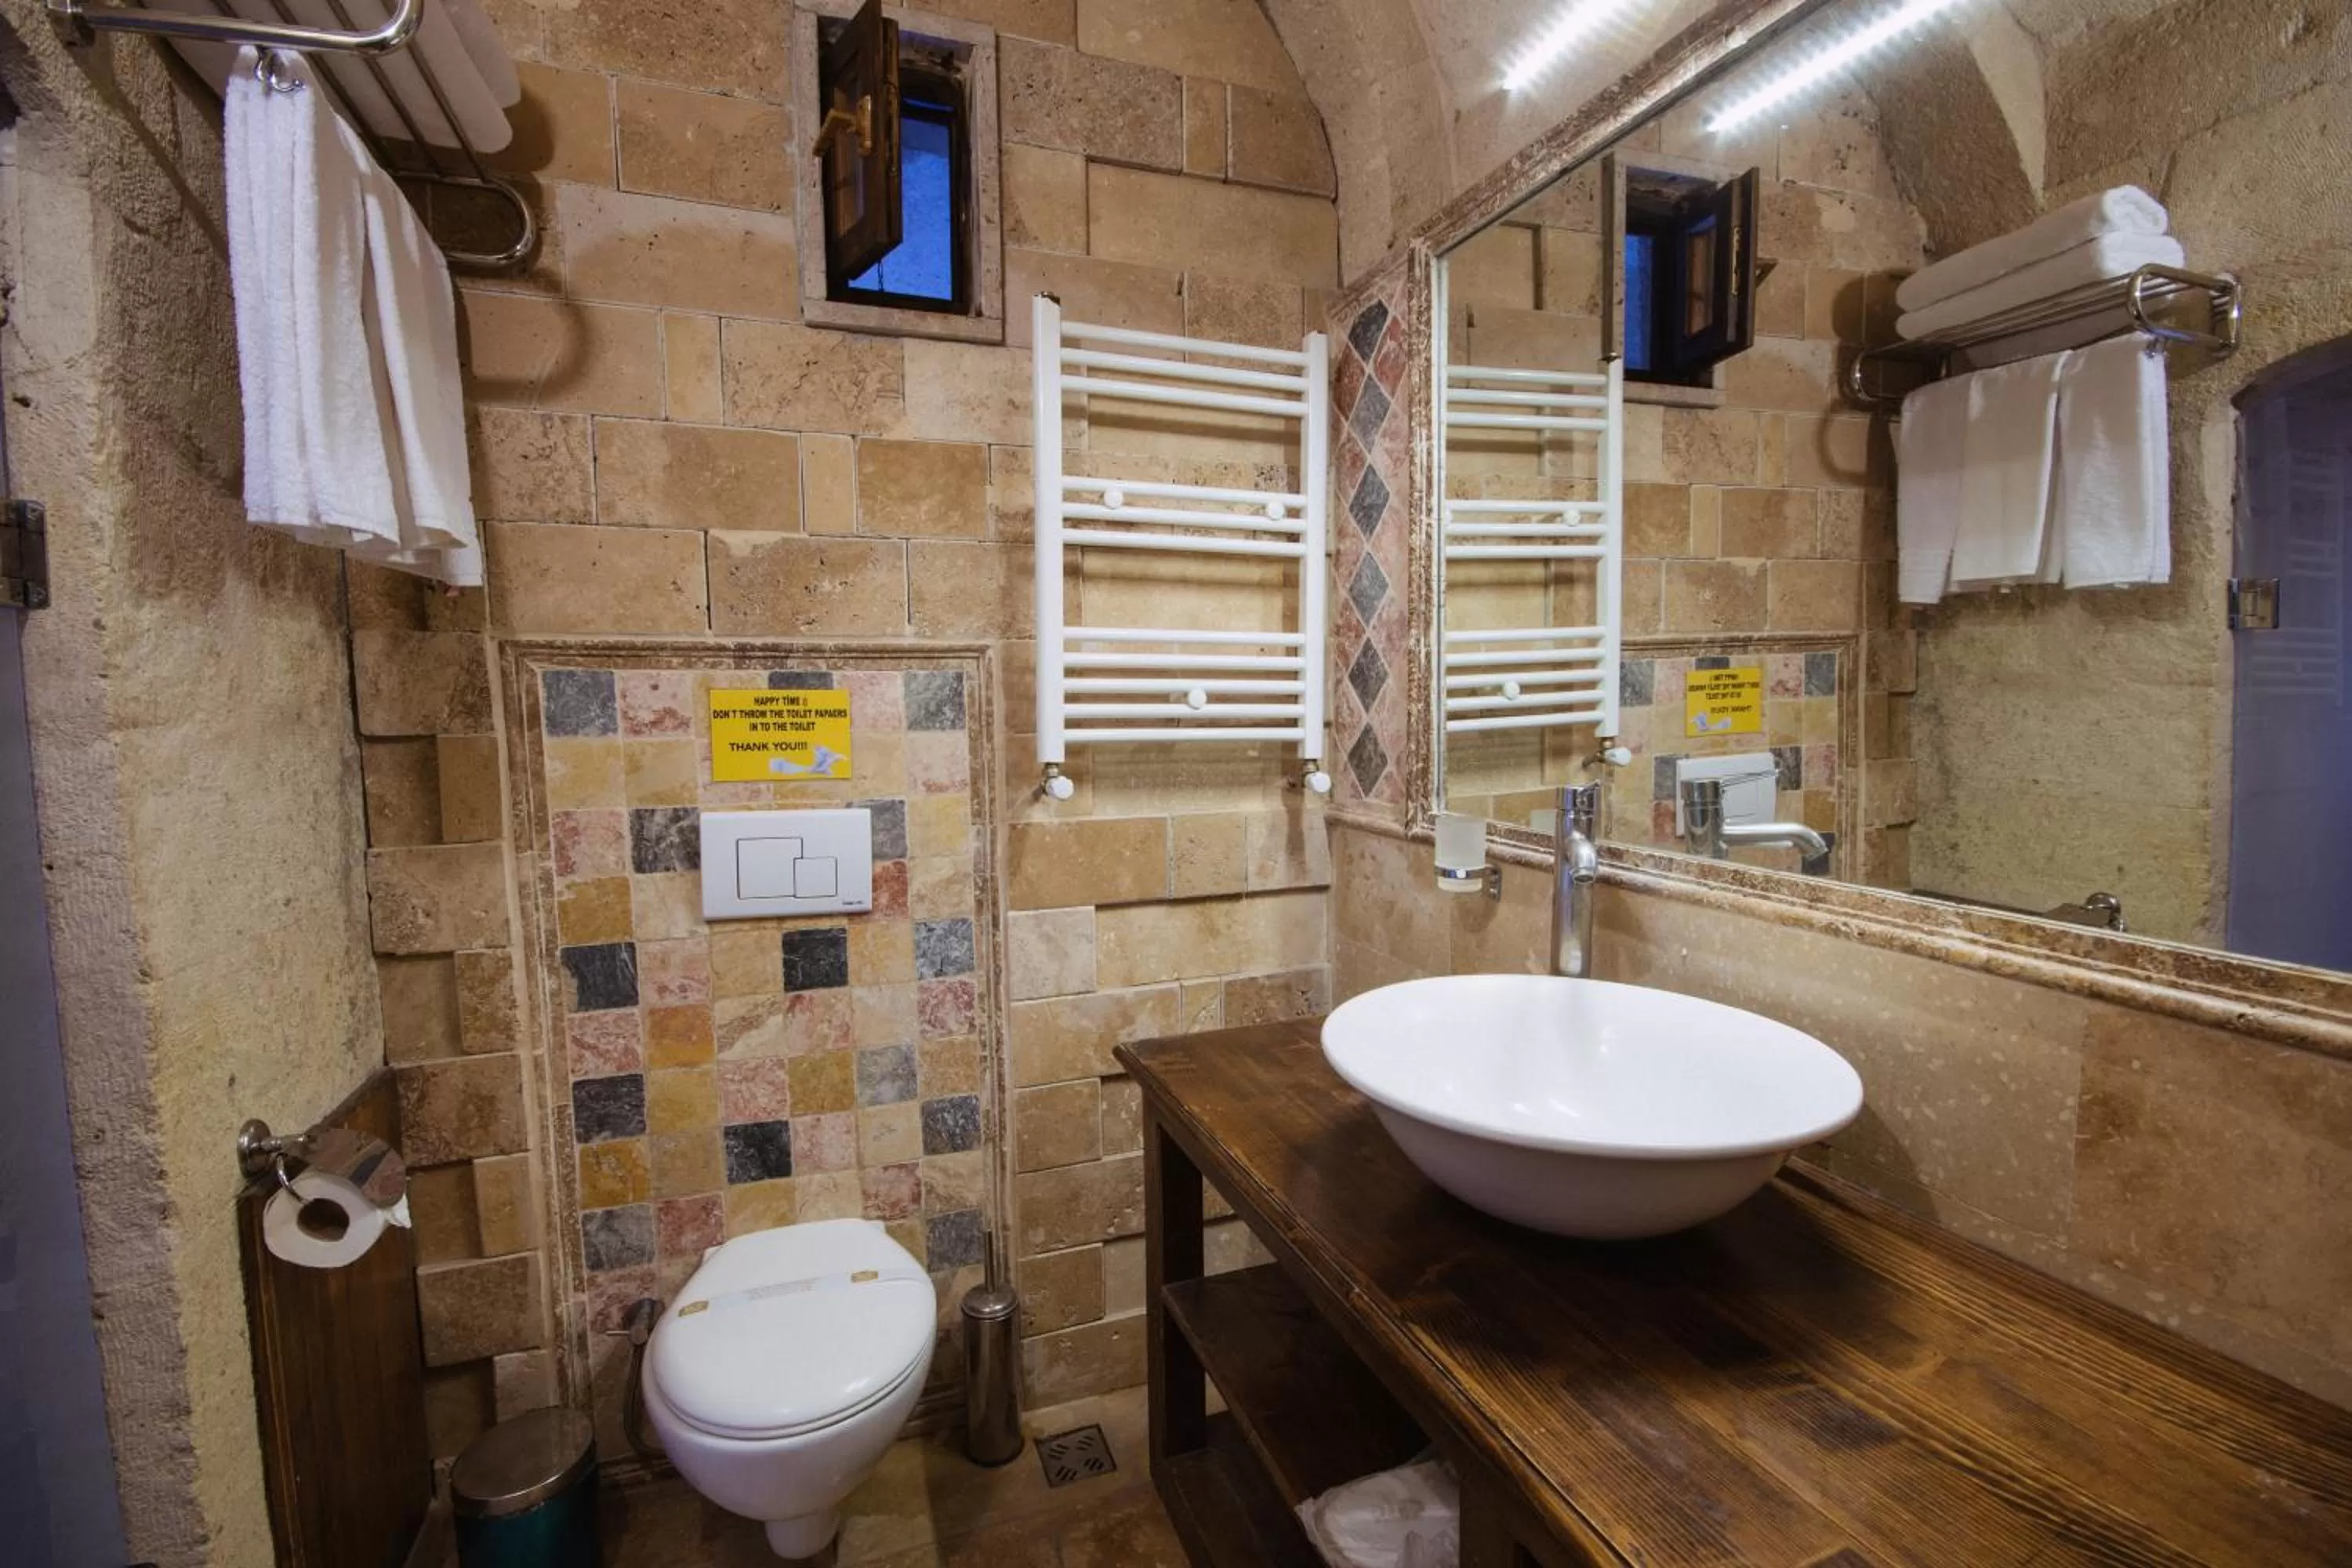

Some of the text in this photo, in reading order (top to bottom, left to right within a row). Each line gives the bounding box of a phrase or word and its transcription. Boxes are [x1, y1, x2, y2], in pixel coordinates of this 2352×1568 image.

[753, 696, 780, 706] HAPPY
[739, 710, 768, 719] THROW
[770, 709, 784, 718] THE
[787, 709, 812, 718] TOILET
[749, 721, 816, 731] IN TO THE TOILET
[728, 742, 769, 753] THANK
